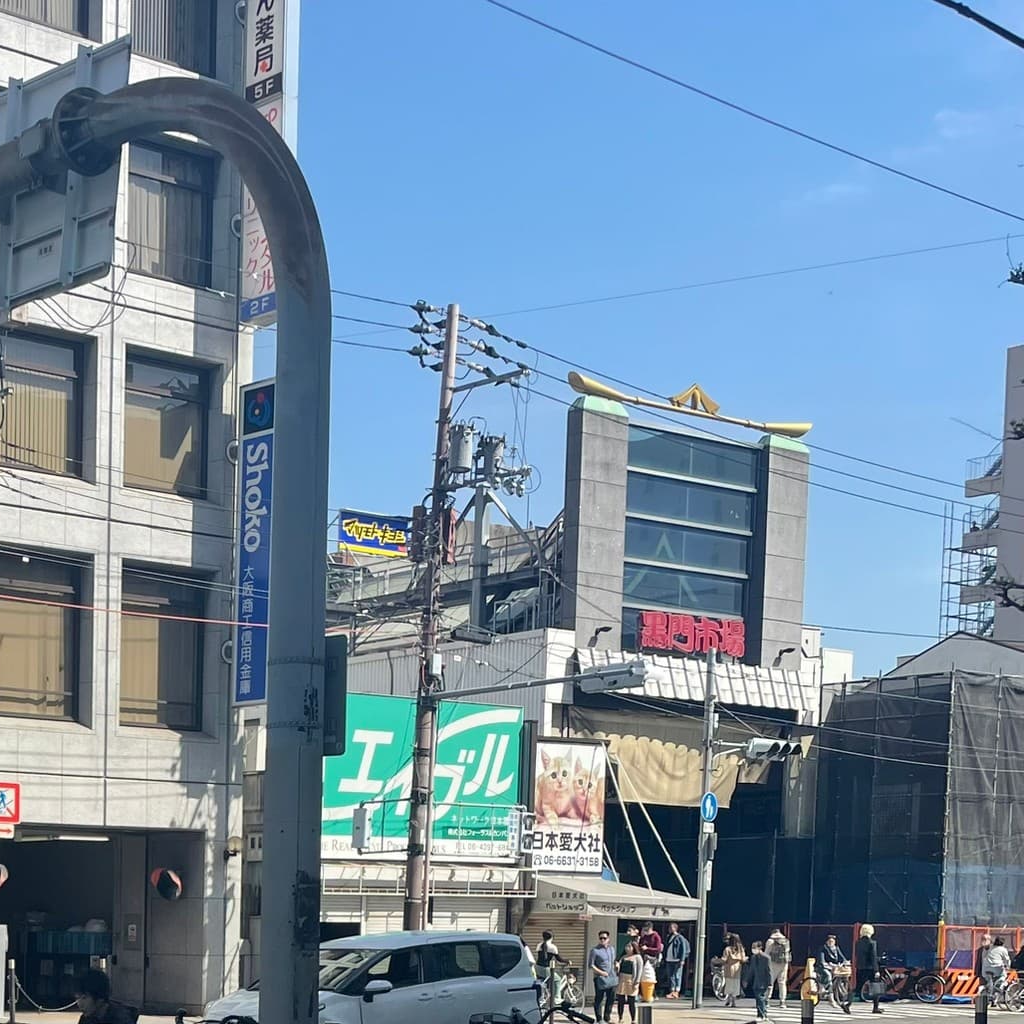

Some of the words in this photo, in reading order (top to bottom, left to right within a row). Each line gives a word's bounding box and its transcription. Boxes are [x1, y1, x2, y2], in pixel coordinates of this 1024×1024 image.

[254, 79, 274, 99] 5F
[250, 297, 270, 315] 2F
[243, 441, 269, 553] Shoko
[239, 565, 255, 695] 大阪商工信用金庫
[533, 831, 601, 853] 日本愛犬社
[543, 855, 600, 867] 06-6631-3158
